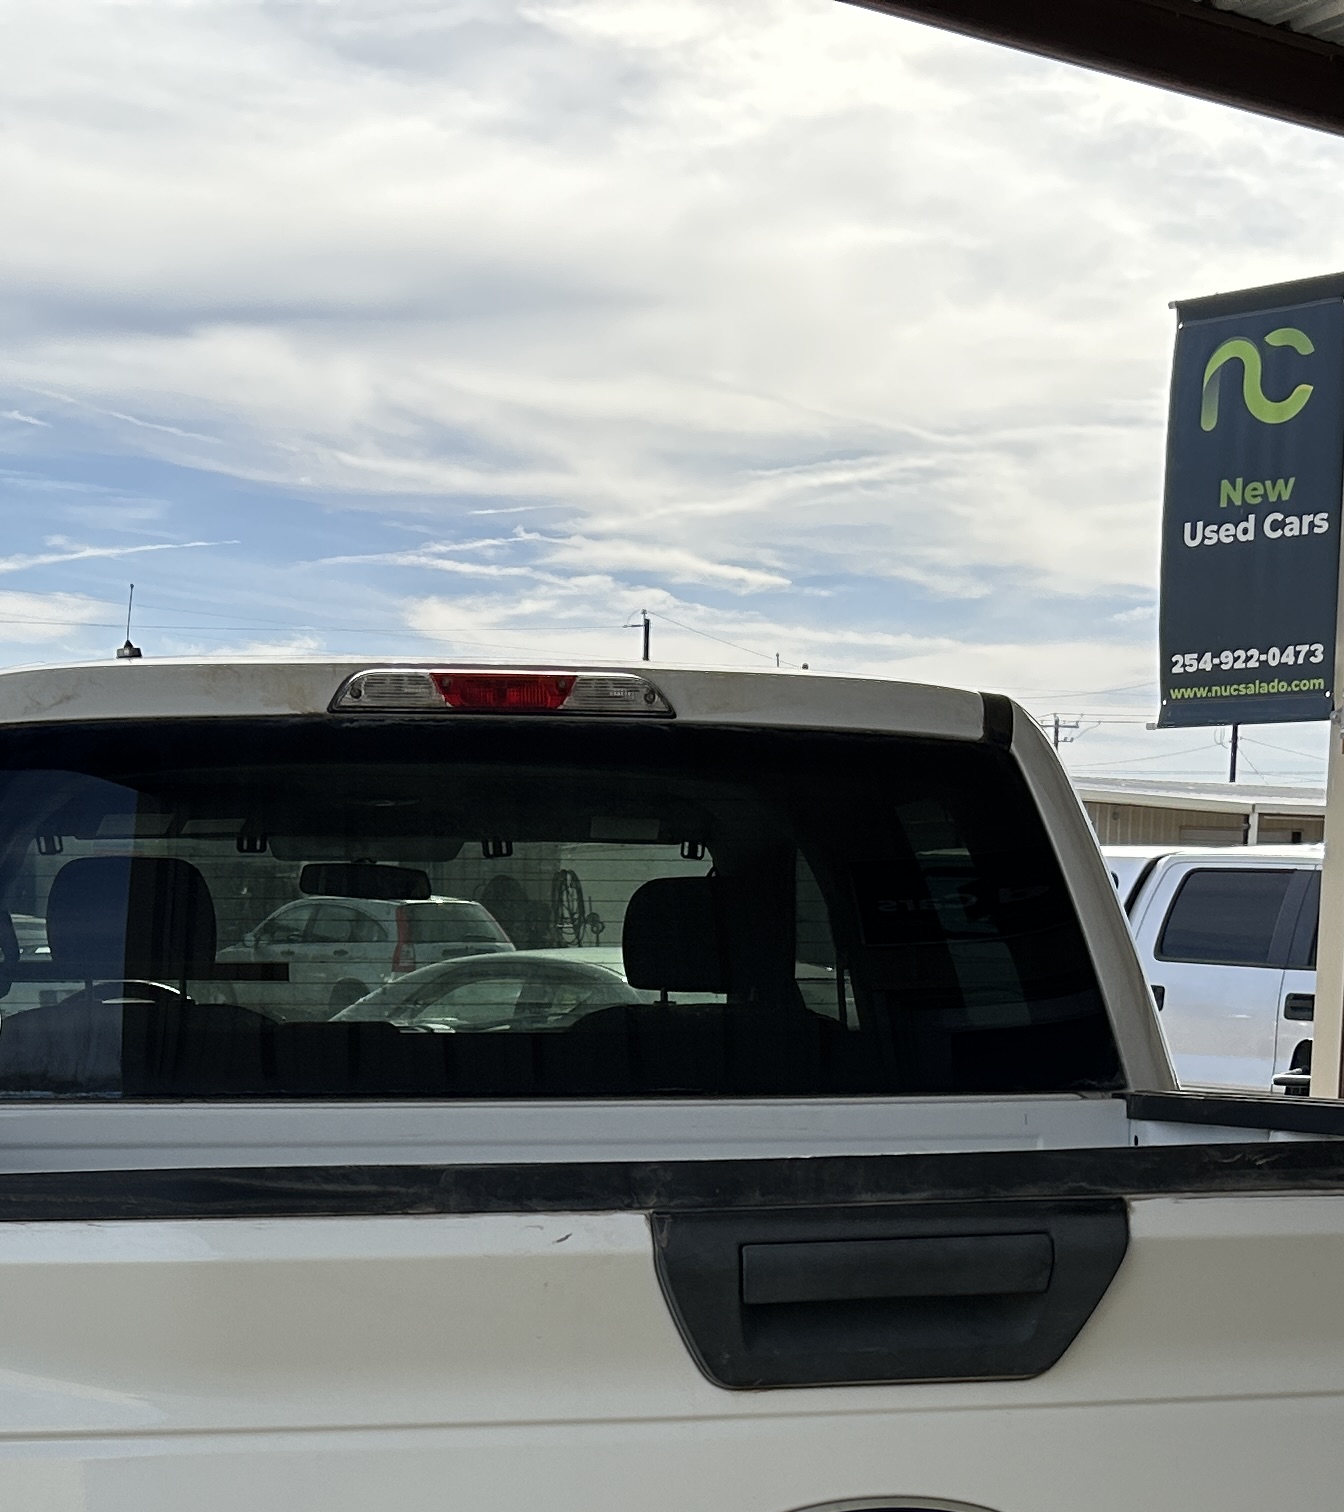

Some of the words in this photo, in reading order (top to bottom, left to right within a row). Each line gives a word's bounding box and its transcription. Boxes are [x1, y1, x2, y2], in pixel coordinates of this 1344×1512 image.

[1219, 476, 1296, 508] New
[1183, 515, 1255, 547] Used
[1263, 510, 1330, 540] Cars
[1170, 643, 1325, 674] 254-922-0473
[1170, 676, 1325, 701] www.nucsalado.com
